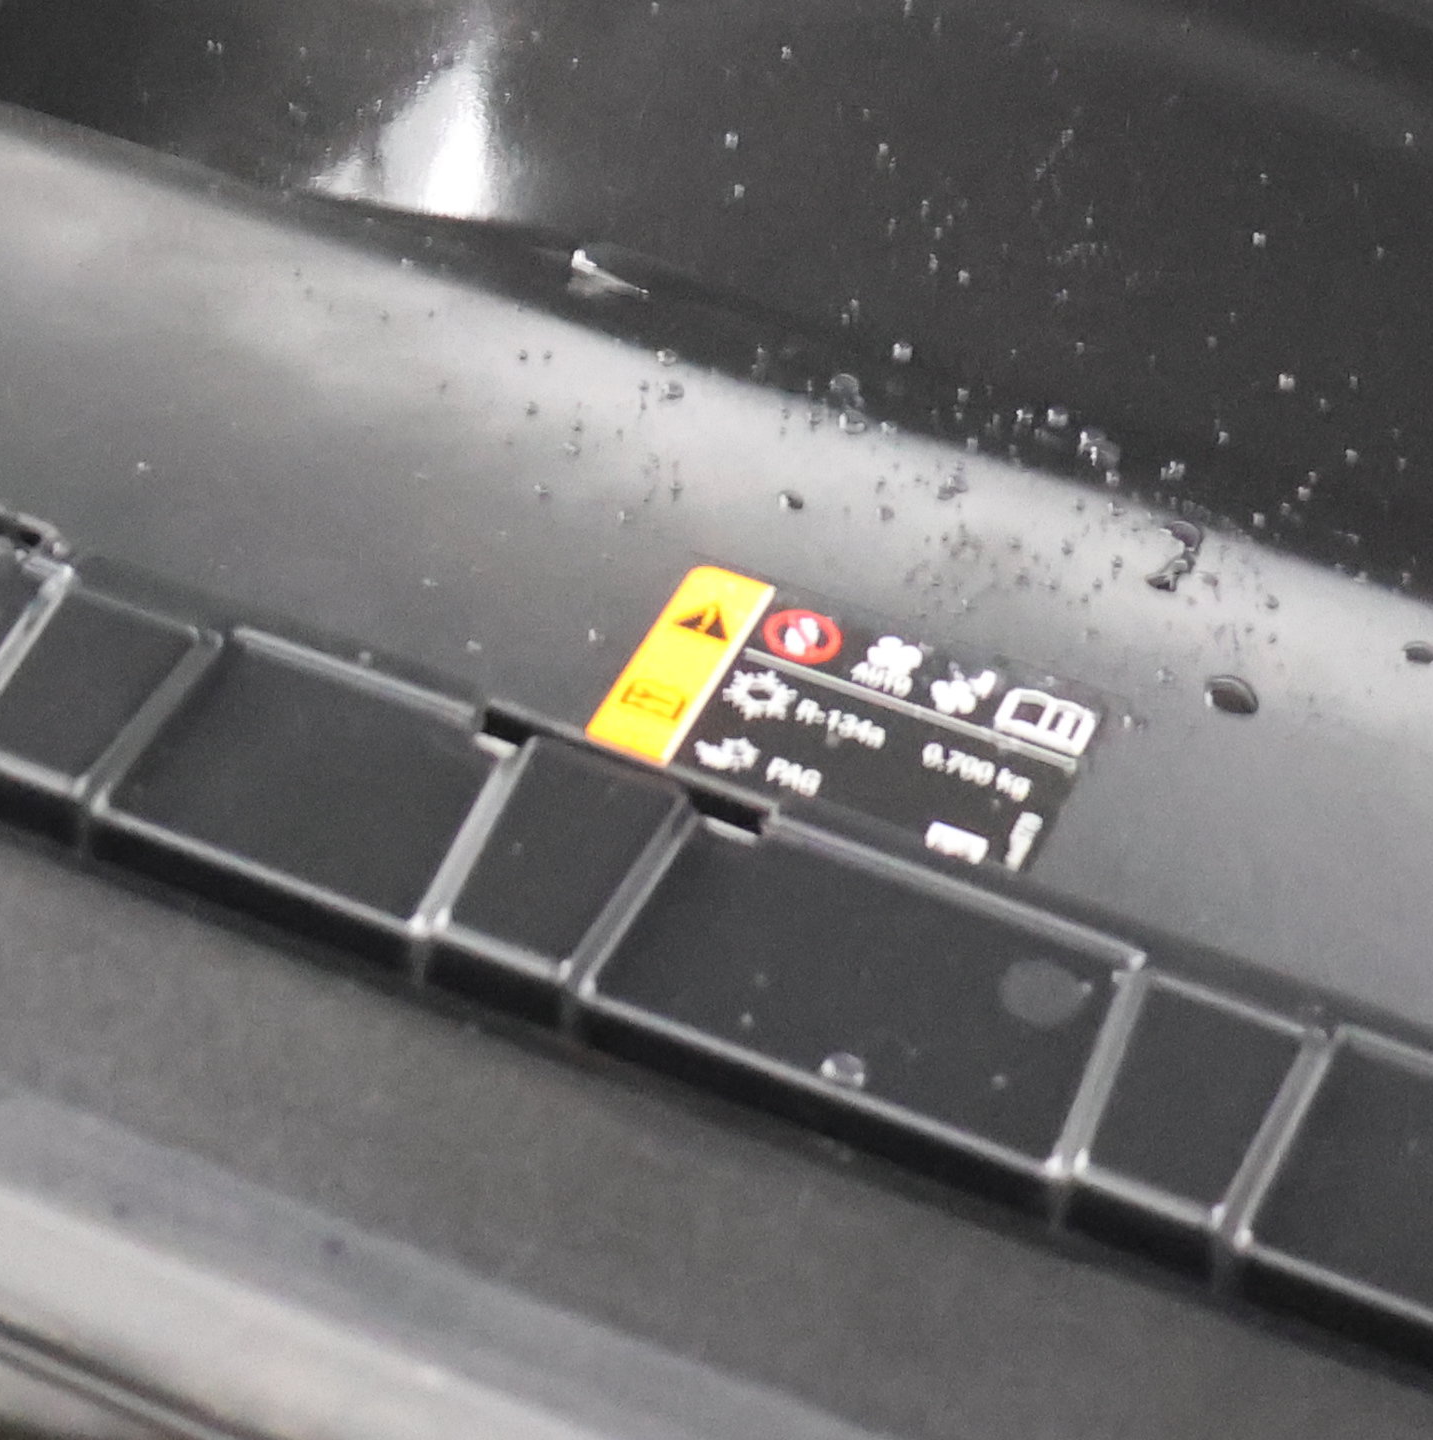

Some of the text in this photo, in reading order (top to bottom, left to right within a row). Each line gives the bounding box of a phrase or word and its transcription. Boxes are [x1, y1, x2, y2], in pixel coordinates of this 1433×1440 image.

[849, 662, 913, 698] AUTO
[795, 698, 1032, 802] R-134a 0.700 kg
[765, 756, 822, 798] PAG
